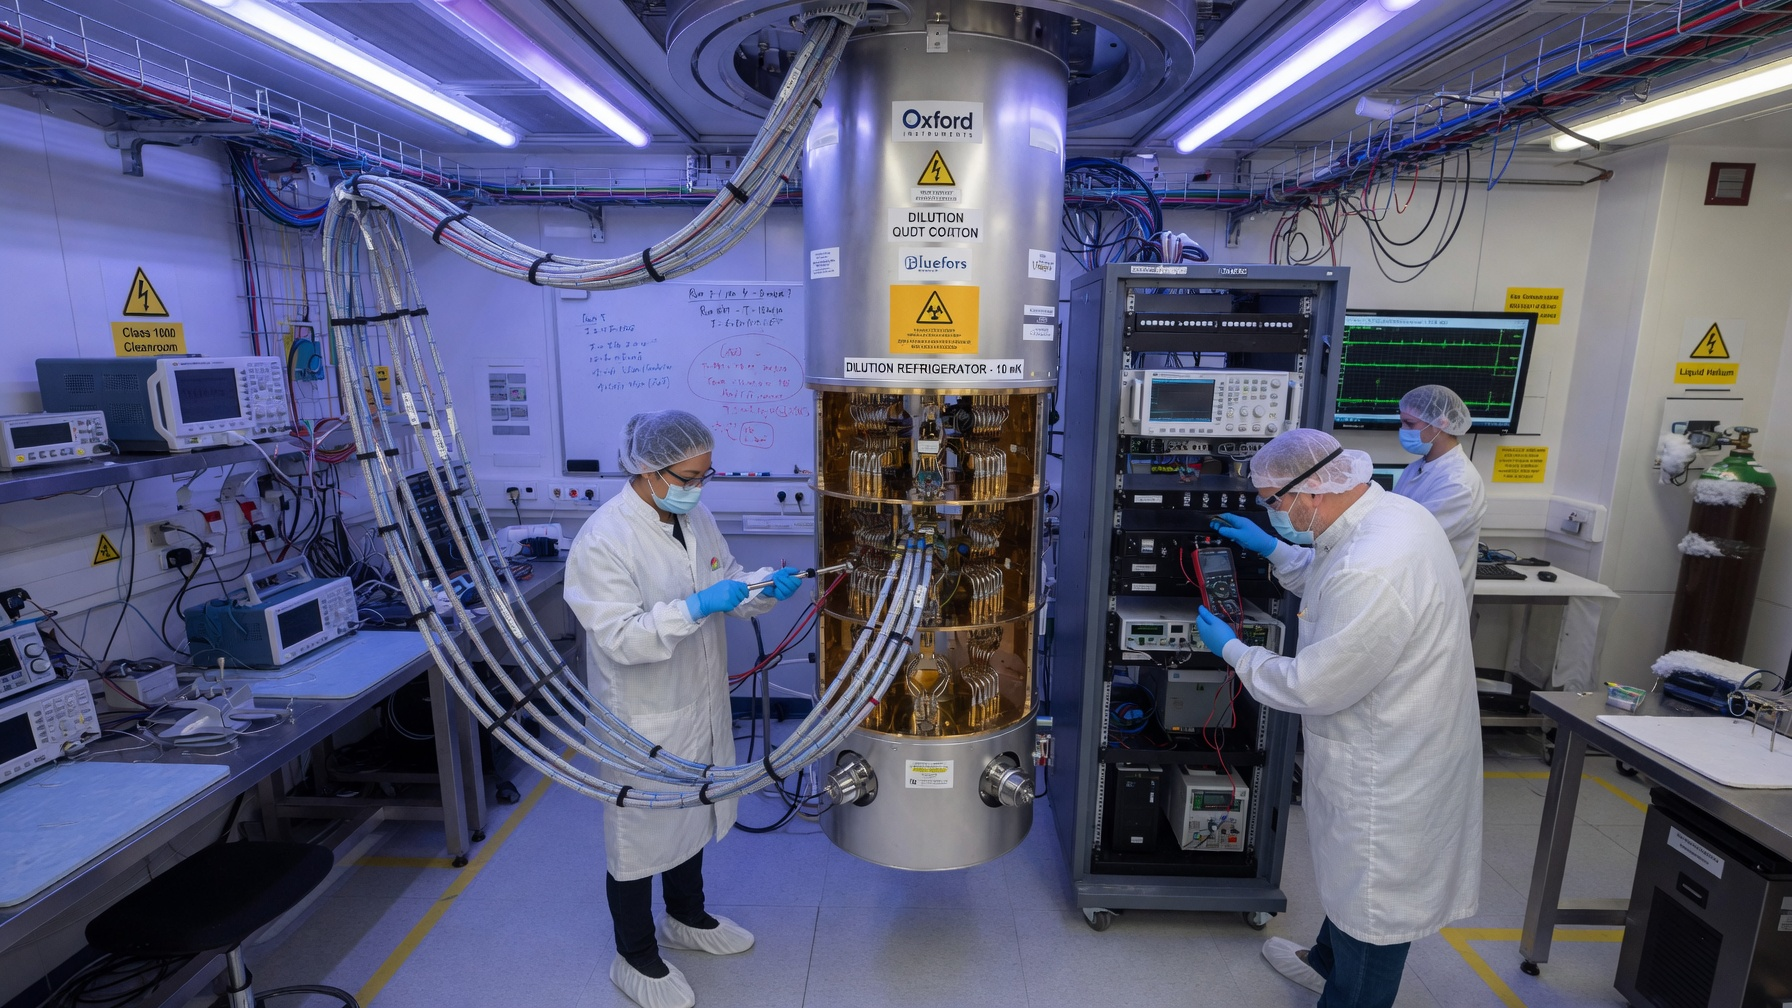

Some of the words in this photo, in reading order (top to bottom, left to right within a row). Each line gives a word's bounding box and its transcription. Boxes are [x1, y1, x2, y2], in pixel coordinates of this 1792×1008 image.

[903, 108, 973, 130] Oxford
[908, 212, 964, 223] DILUTION
[122, 327, 151, 338] Class
[123, 341, 178, 352] Cleanroom
[846, 362, 894, 374] DILUTION
[897, 363, 987, 375] REFRIGERATOR
